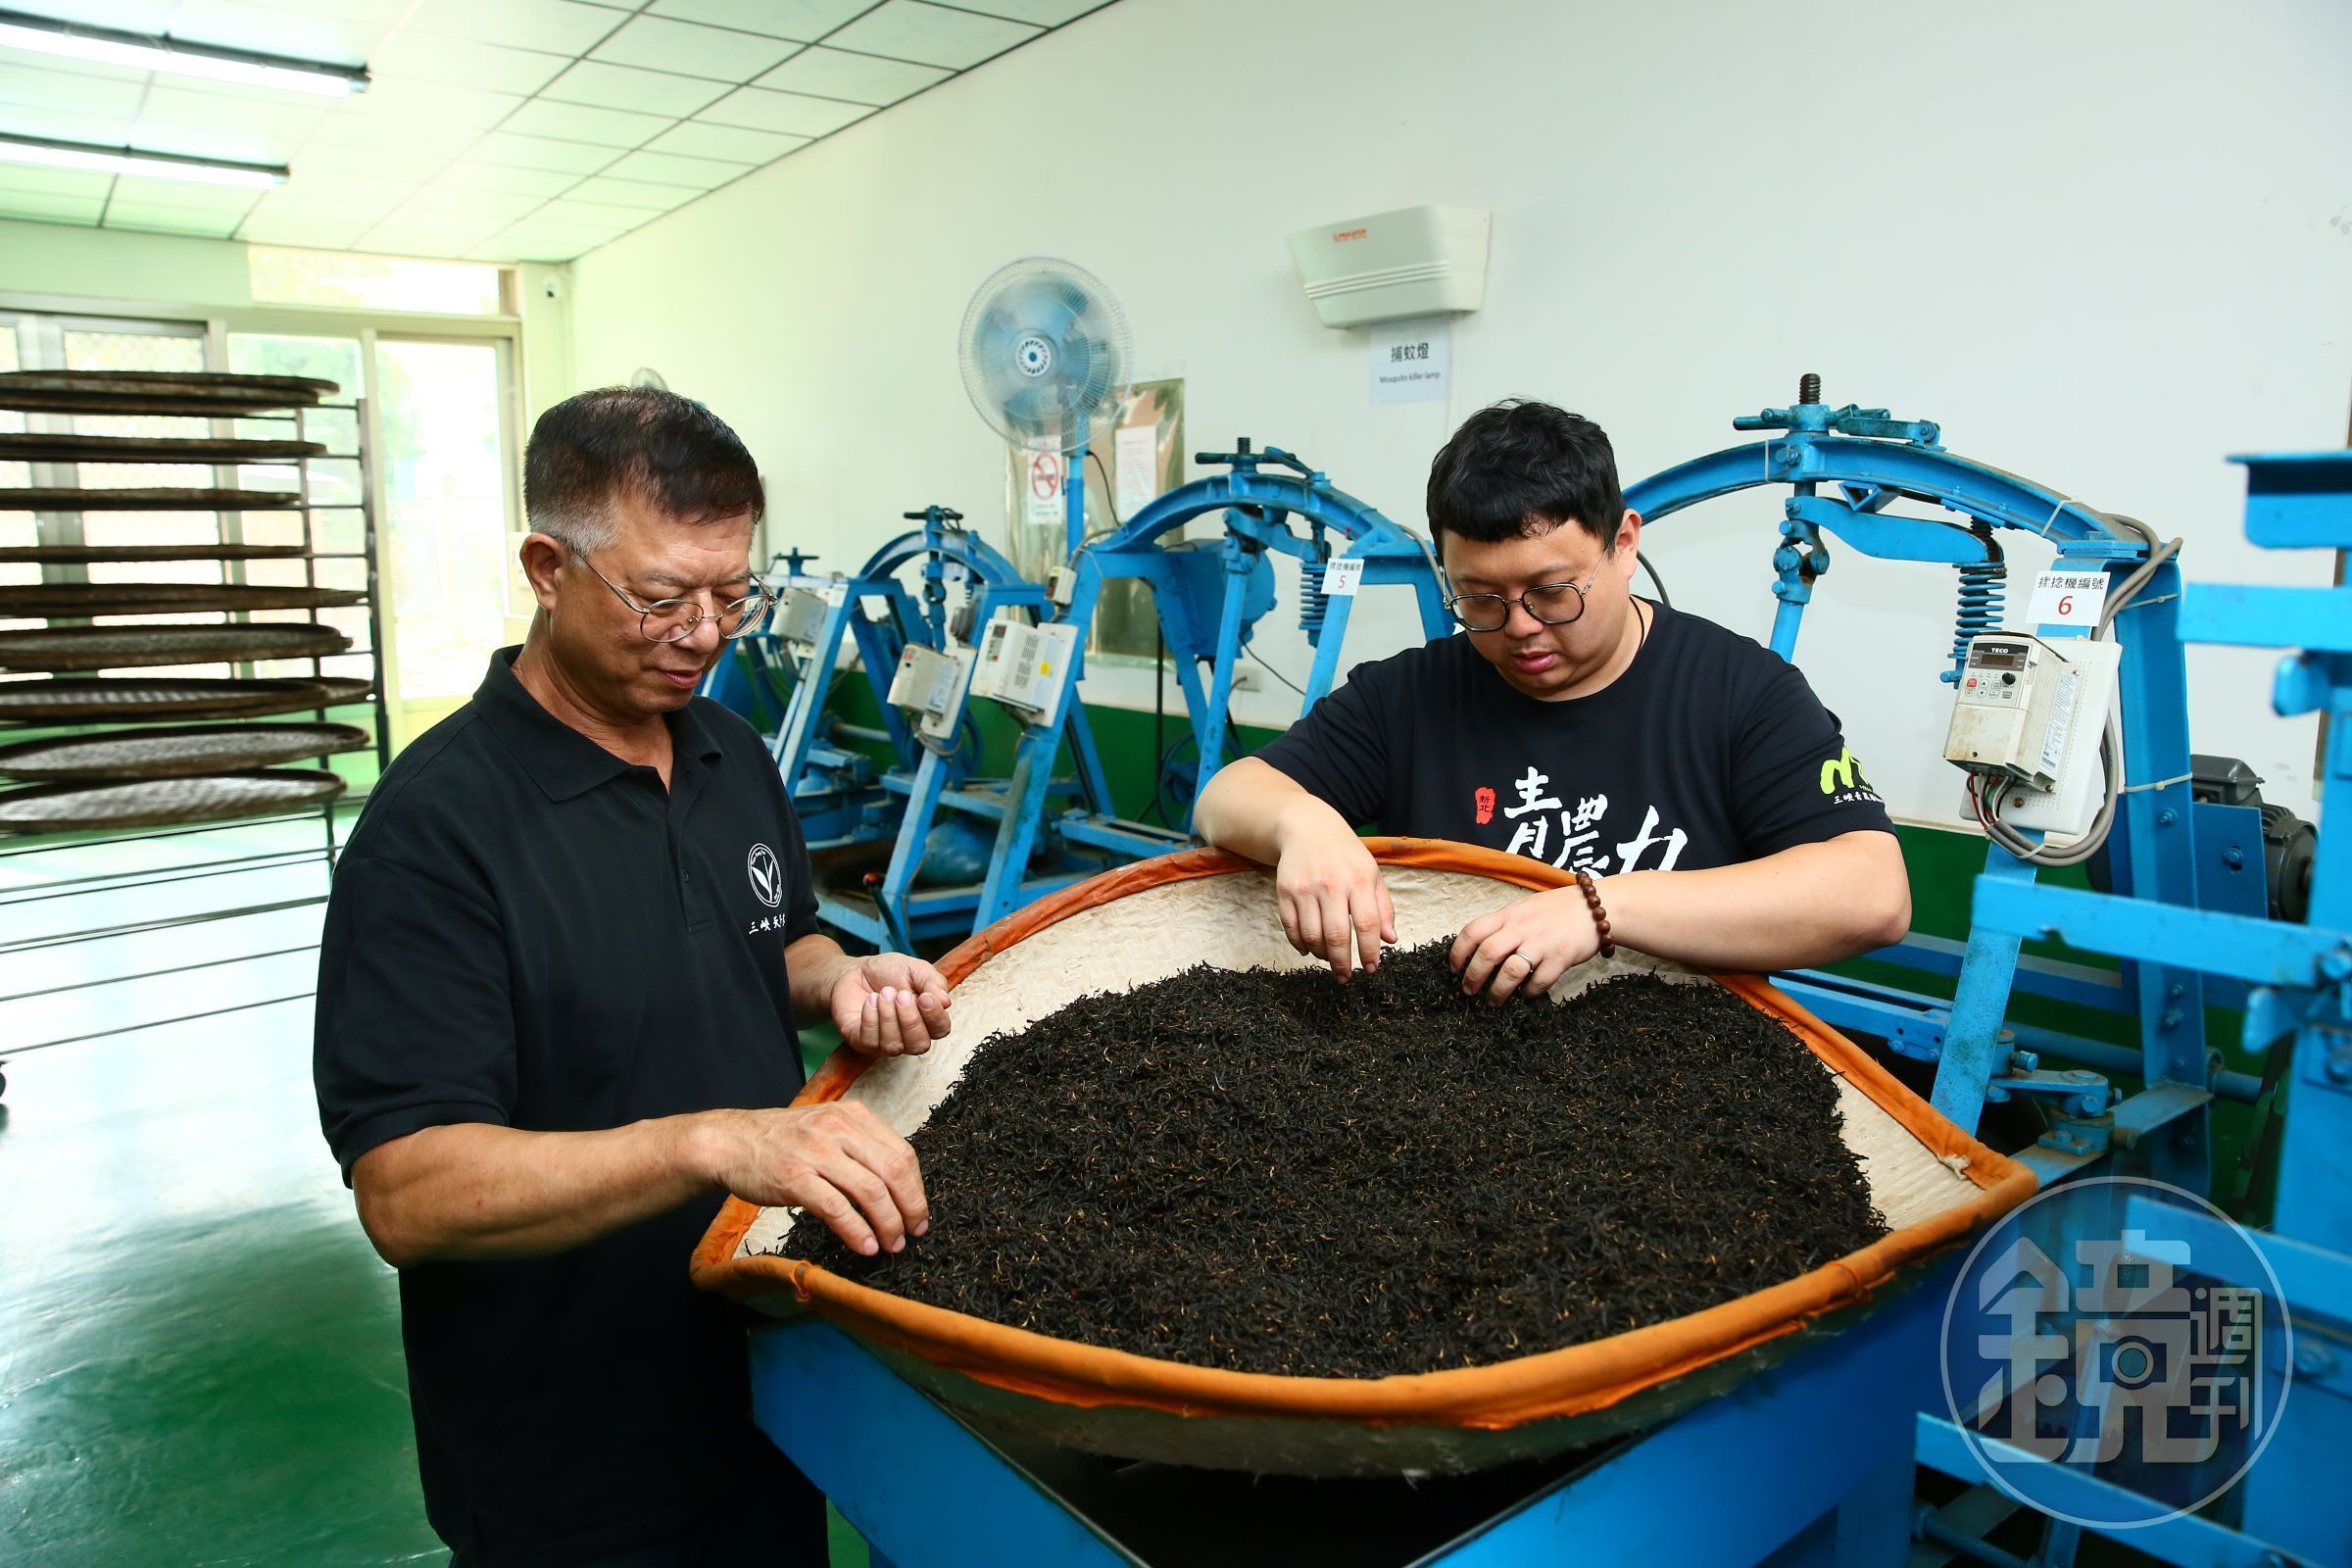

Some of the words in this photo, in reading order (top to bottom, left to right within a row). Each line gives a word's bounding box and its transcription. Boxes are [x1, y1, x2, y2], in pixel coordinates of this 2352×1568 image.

[1391, 342, 1429, 363] 捕蚊燈
[1380, 374, 1407, 383] Mosquito
[1338, 574, 1347, 589] 5
[2058, 595, 2074, 615] 6
[1478, 795, 1491, 812] 新北
